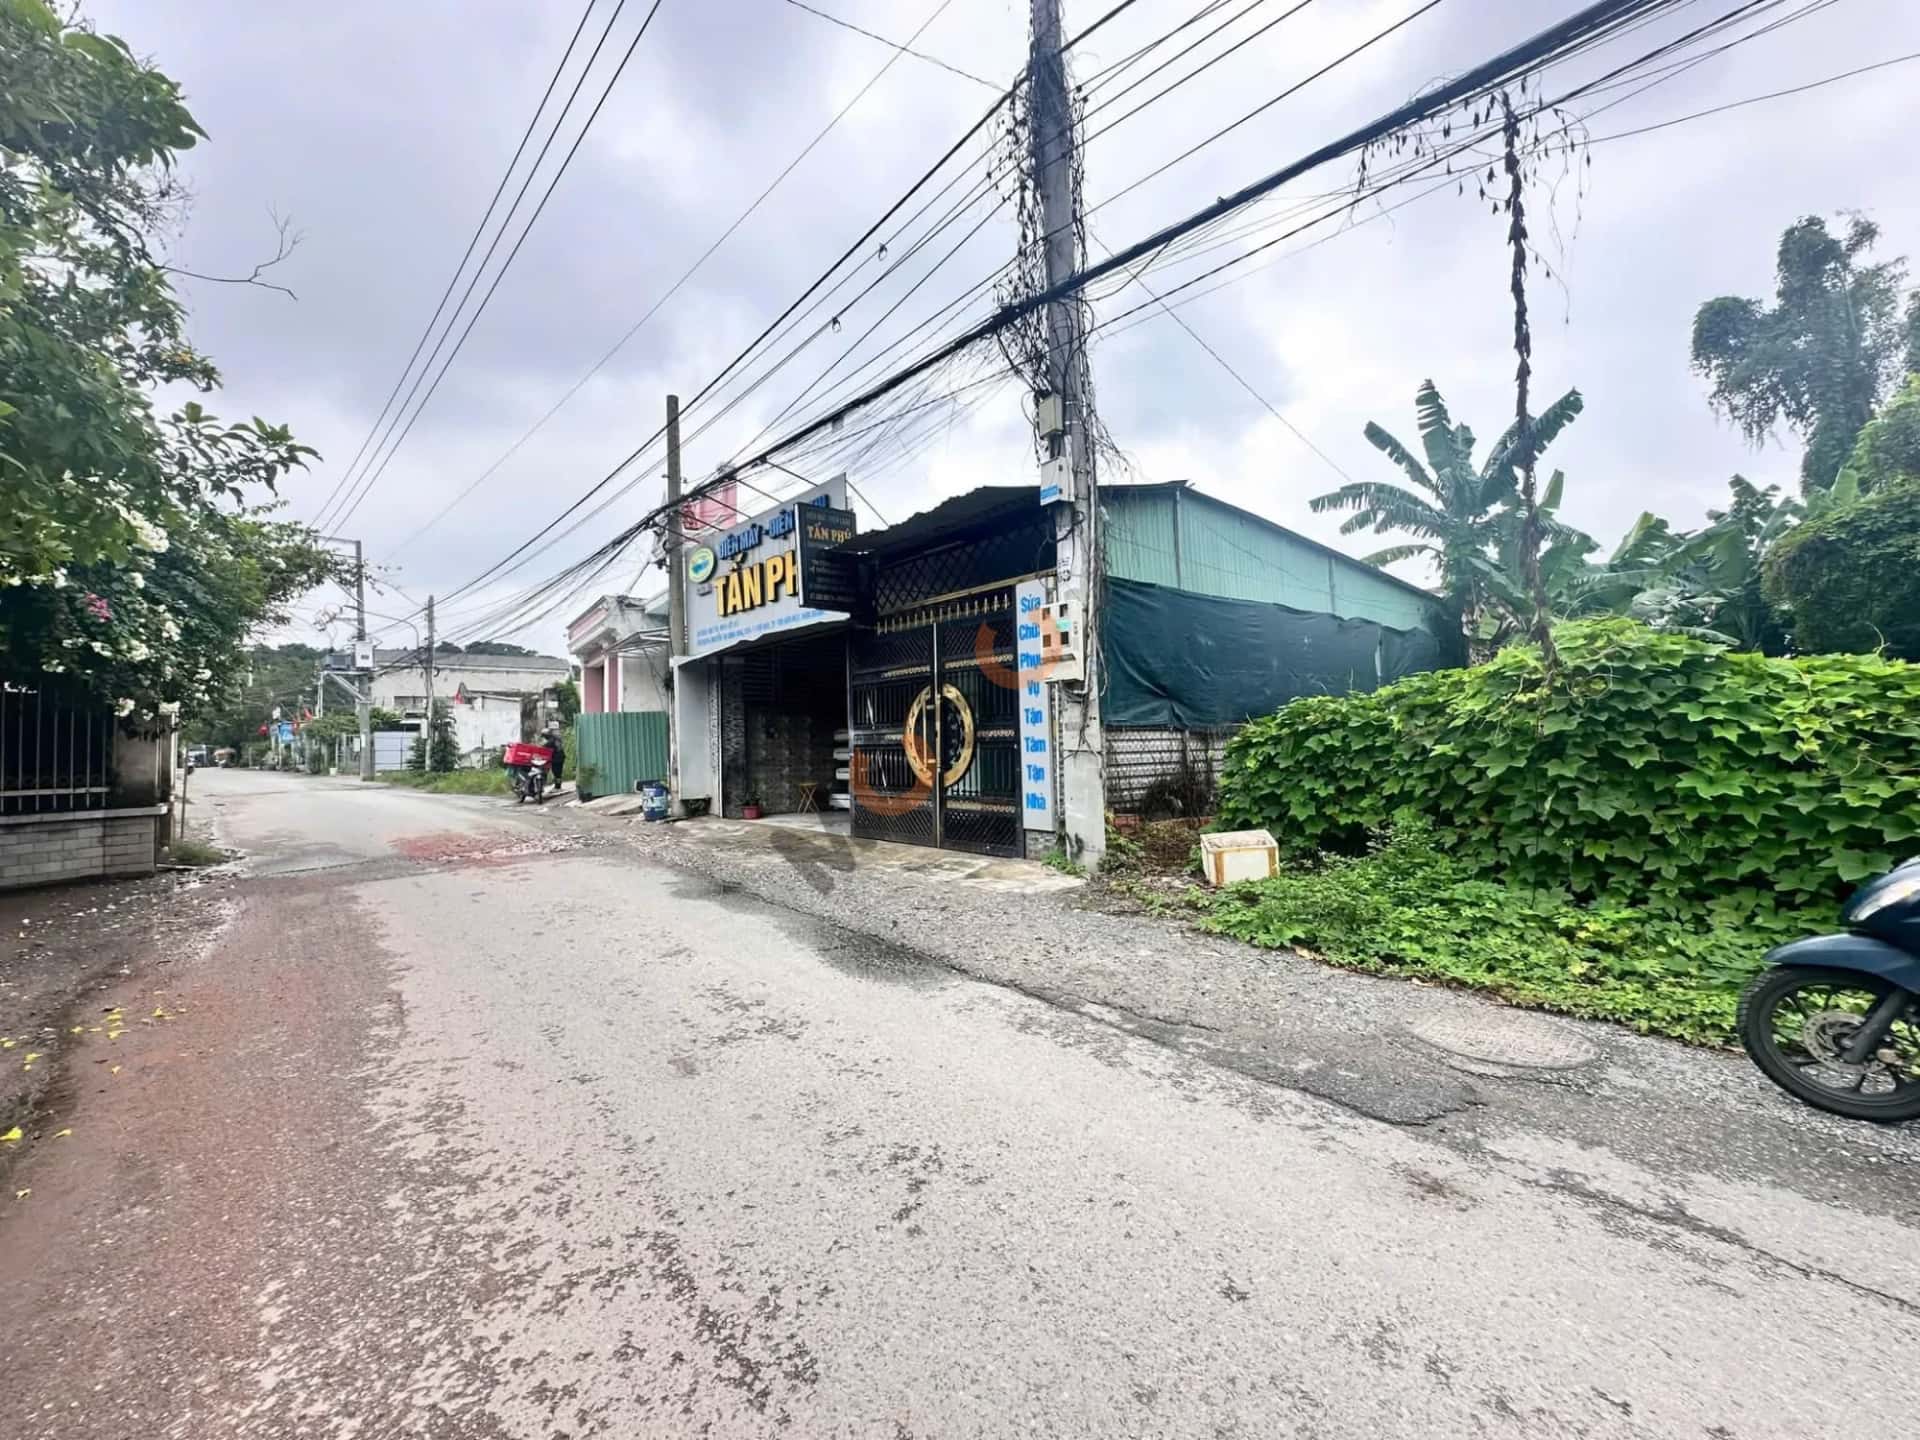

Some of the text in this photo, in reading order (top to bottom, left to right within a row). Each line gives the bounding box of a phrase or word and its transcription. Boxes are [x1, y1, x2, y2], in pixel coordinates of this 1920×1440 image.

[713, 552, 764, 617] TẤN
[766, 549, 797, 601] PH
[1026, 792, 1047, 811] Nhà
